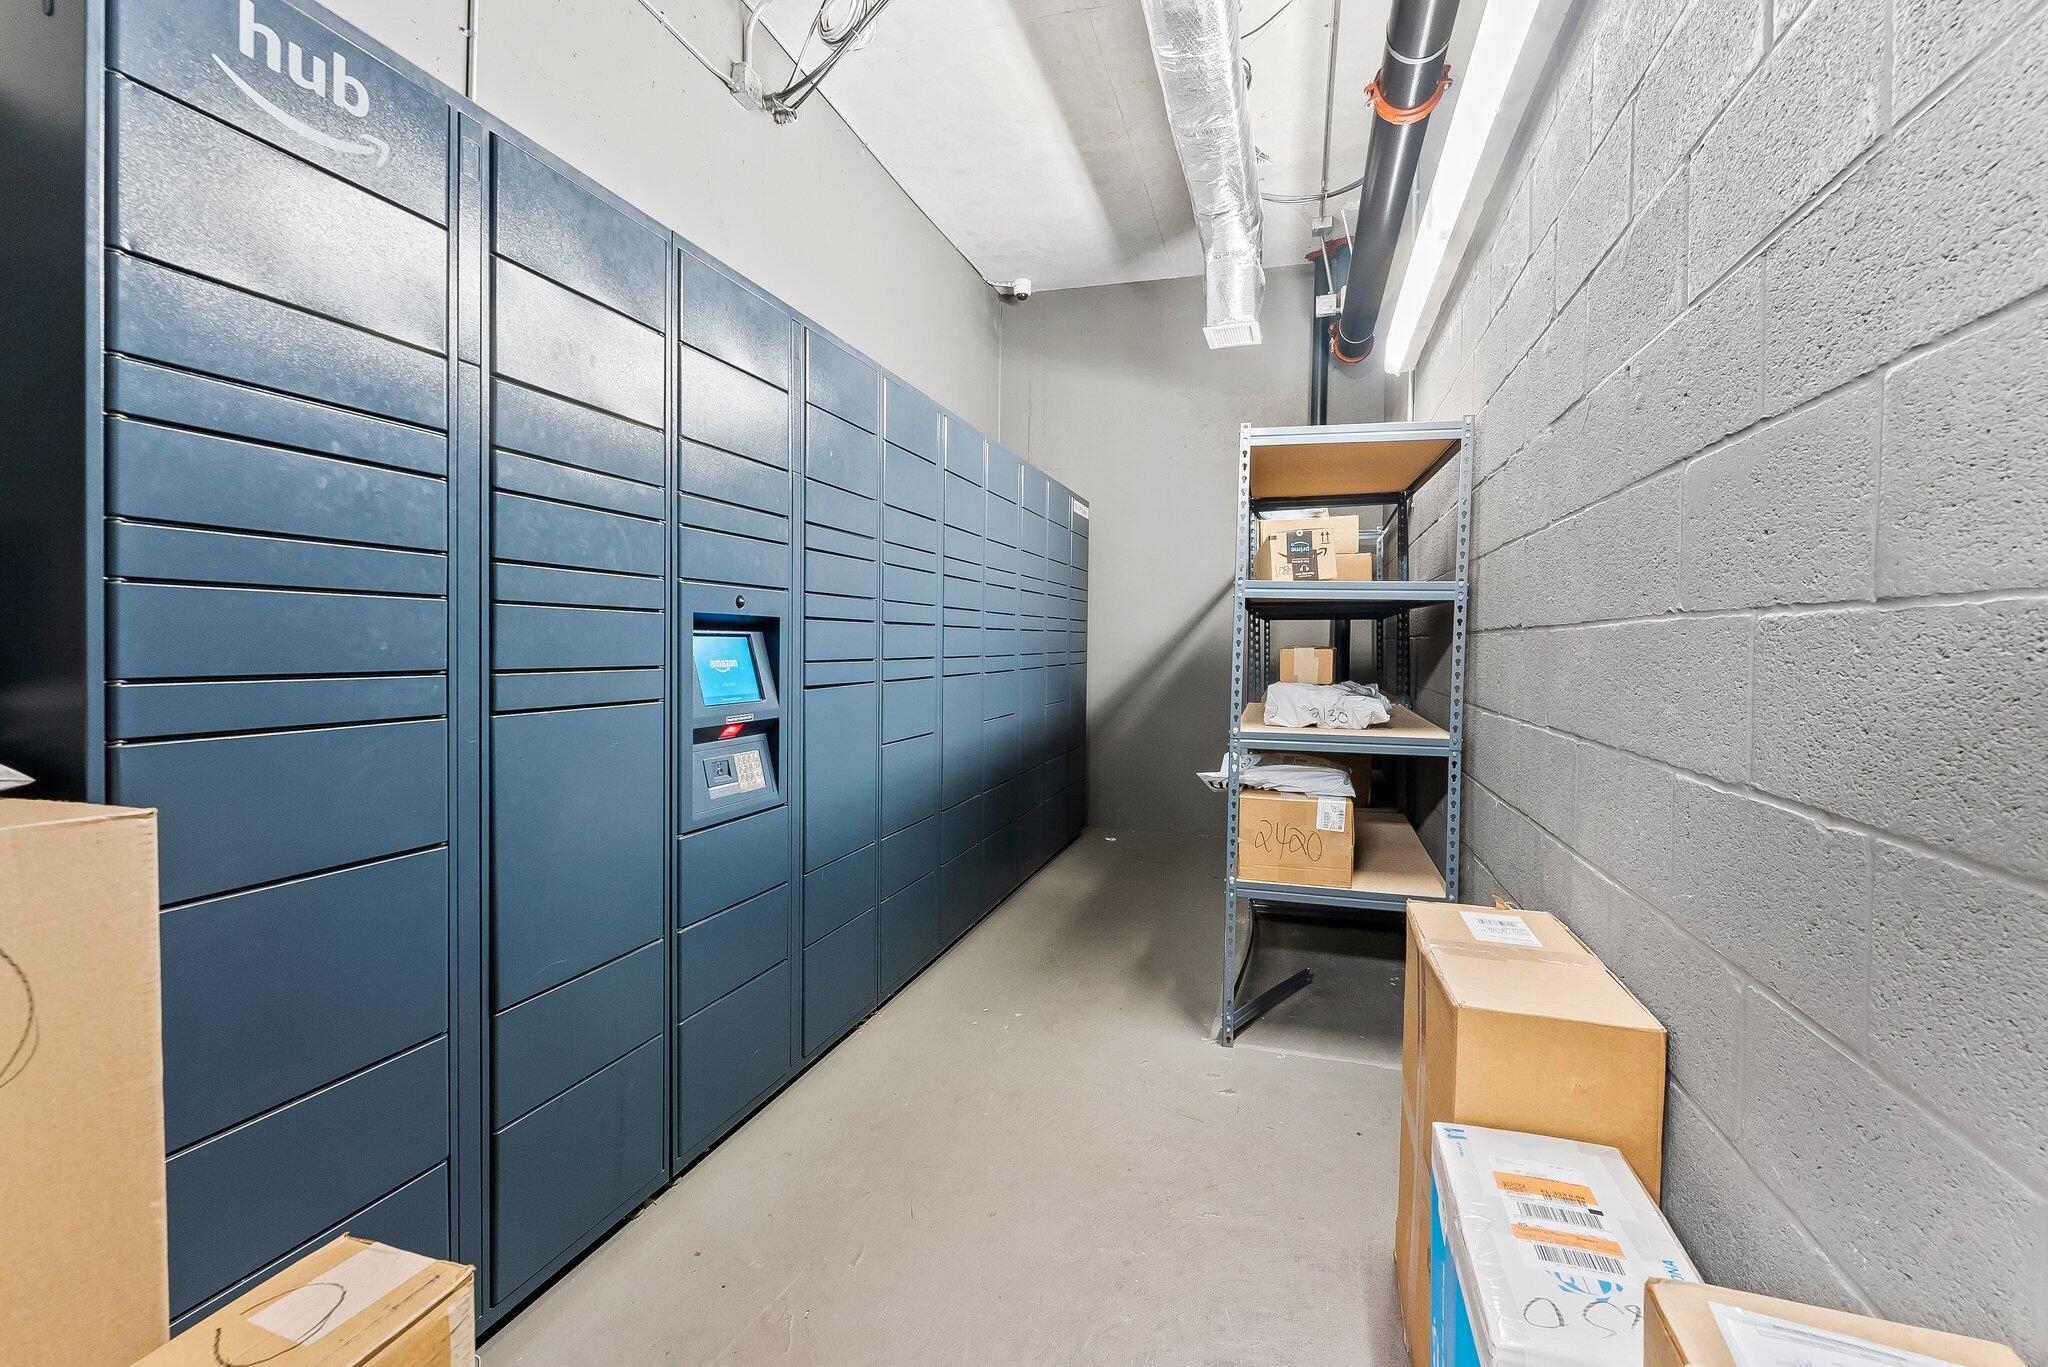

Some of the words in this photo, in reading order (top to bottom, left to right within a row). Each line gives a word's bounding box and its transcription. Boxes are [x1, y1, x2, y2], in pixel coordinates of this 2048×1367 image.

[239, 0, 370, 118] hub
[709, 659, 738, 669] amazon
[1309, 707, 1348, 724] 2130
[1254, 819, 1323, 862] 2420
